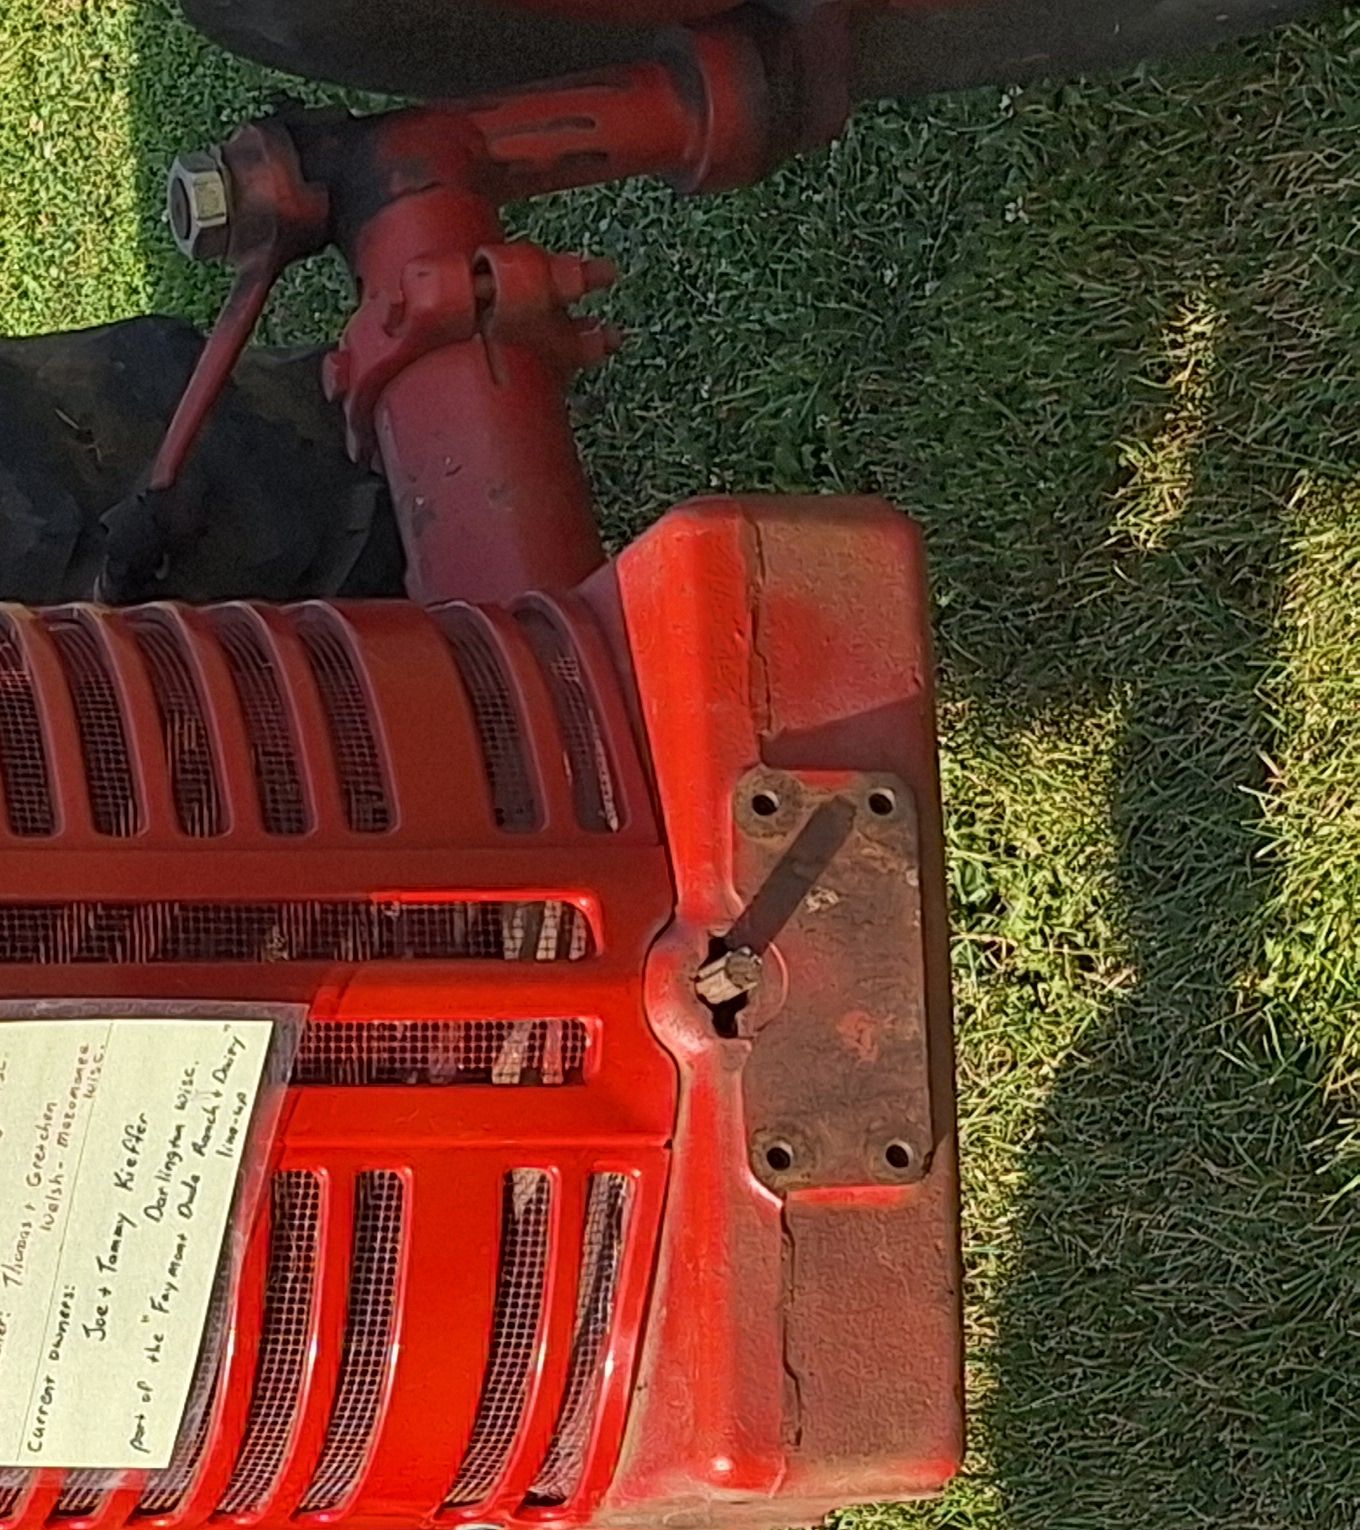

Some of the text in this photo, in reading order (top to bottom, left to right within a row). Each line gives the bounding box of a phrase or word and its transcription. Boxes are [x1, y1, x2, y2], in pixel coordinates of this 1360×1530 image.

[191, 1105, 220, 1157] Ranch
[215, 1092, 248, 1158] line-up
[0, 1221, 33, 1288] Thomas
[26, 1101, 58, 1187] Gretchen
[143, 1124, 186, 1223] Darlington
[82, 1304, 109, 1342] Joe
[113, 1112, 148, 1192] Kieffer
[48, 1284, 75, 1361] owners:
[140, 1333, 164, 1363] the
[137, 1380, 153, 1403] of
[129, 1413, 151, 1454] part
